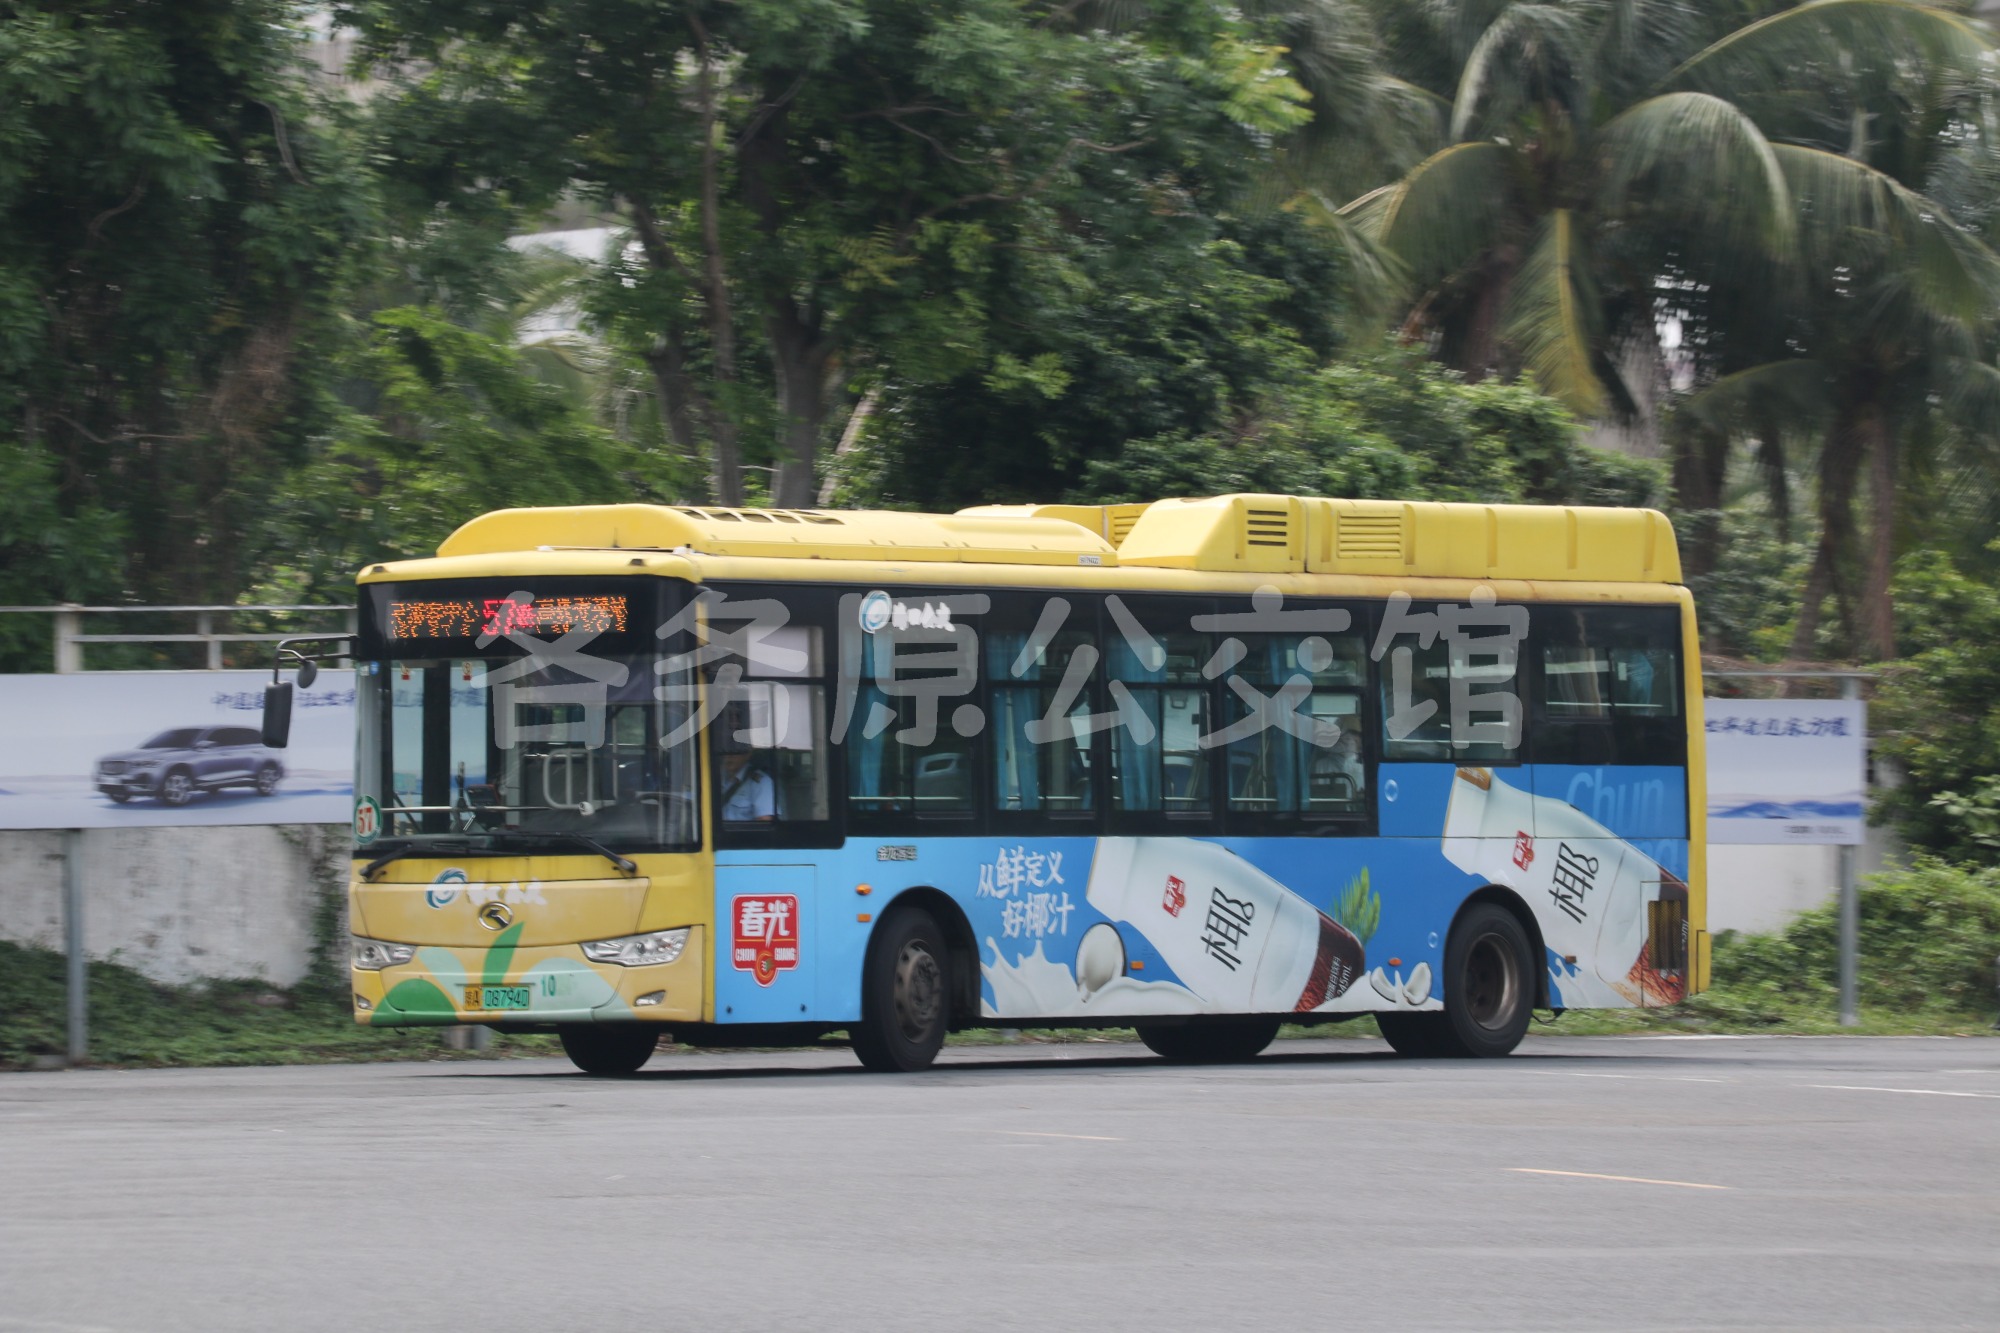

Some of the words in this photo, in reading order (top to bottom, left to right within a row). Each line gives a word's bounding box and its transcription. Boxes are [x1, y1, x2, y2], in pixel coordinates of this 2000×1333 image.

[976, 845, 1065, 899] 从鲜定义
[740, 900, 790, 948] 春光
[1001, 891, 1076, 938] 好椰汁
